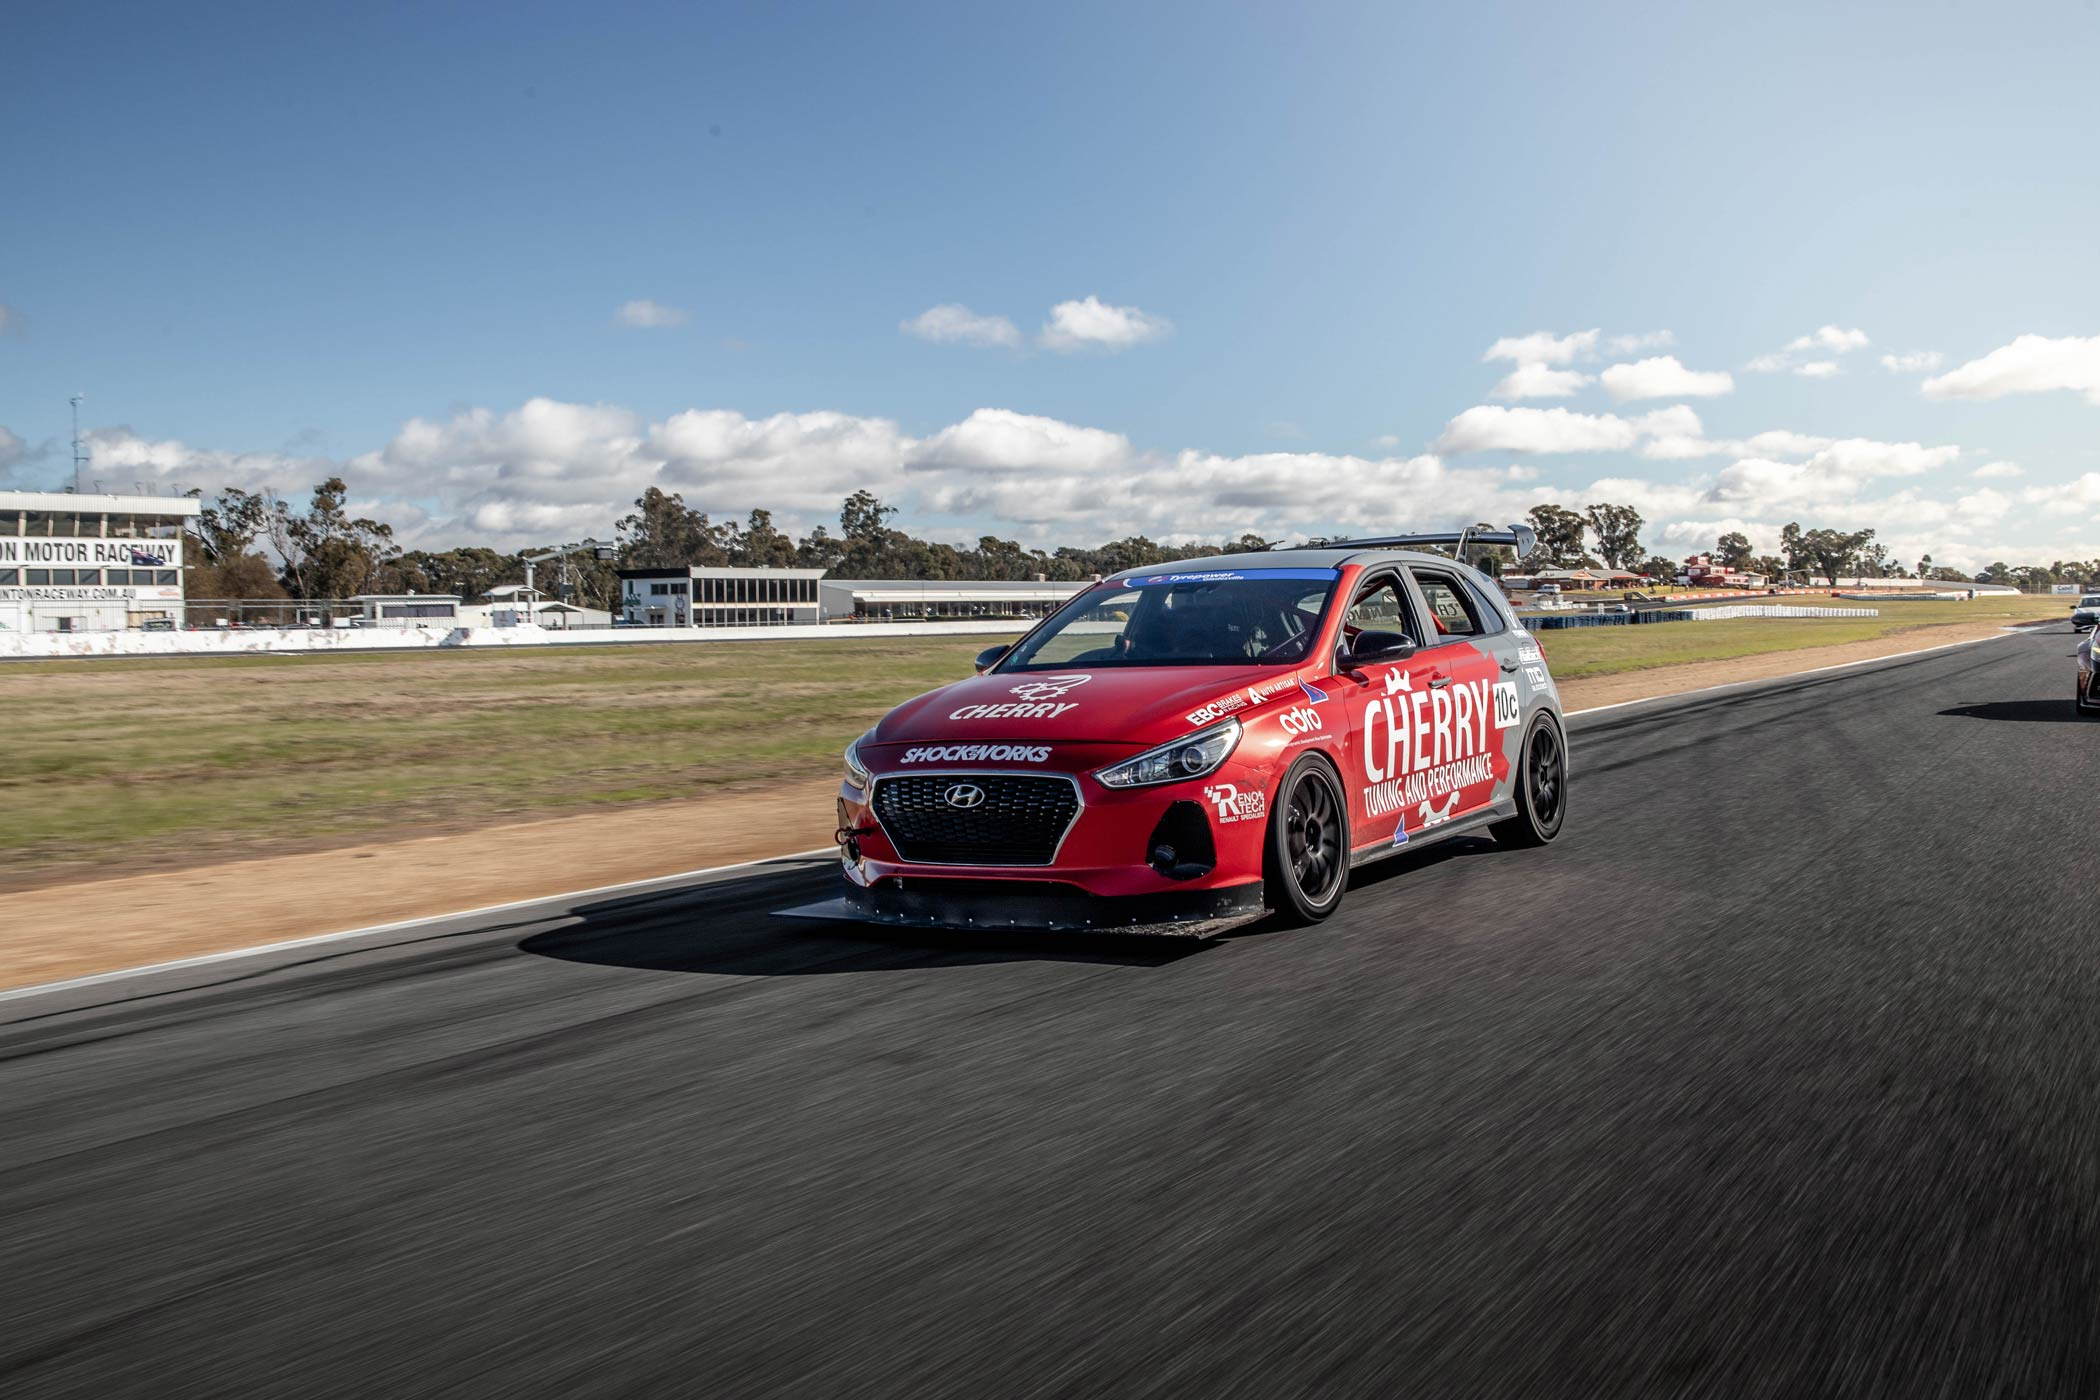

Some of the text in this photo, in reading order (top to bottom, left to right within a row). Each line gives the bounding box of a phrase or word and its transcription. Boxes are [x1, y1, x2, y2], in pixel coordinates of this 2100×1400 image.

[25, 542, 88, 562] MOTOR
[95, 543, 175, 563] RACWAY
[1169, 572, 1235, 582] Tyrepower
[1260, 685, 1276, 697] AUTO
[1273, 678, 1296, 692] ARTISAN
[1216, 693, 1242, 708] BRAKES
[1221, 701, 1248, 713] RACING
[1495, 687, 1518, 723] 10c
[949, 702, 1080, 720] CHERRY
[1185, 703, 1224, 726] EBC
[1363, 678, 1490, 783] CHERRY
[900, 744, 1053, 764] SHOCKWORKS
[1363, 752, 1494, 819] TUNING AND PERFORMANCE
[1239, 797, 1265, 815] TECH
